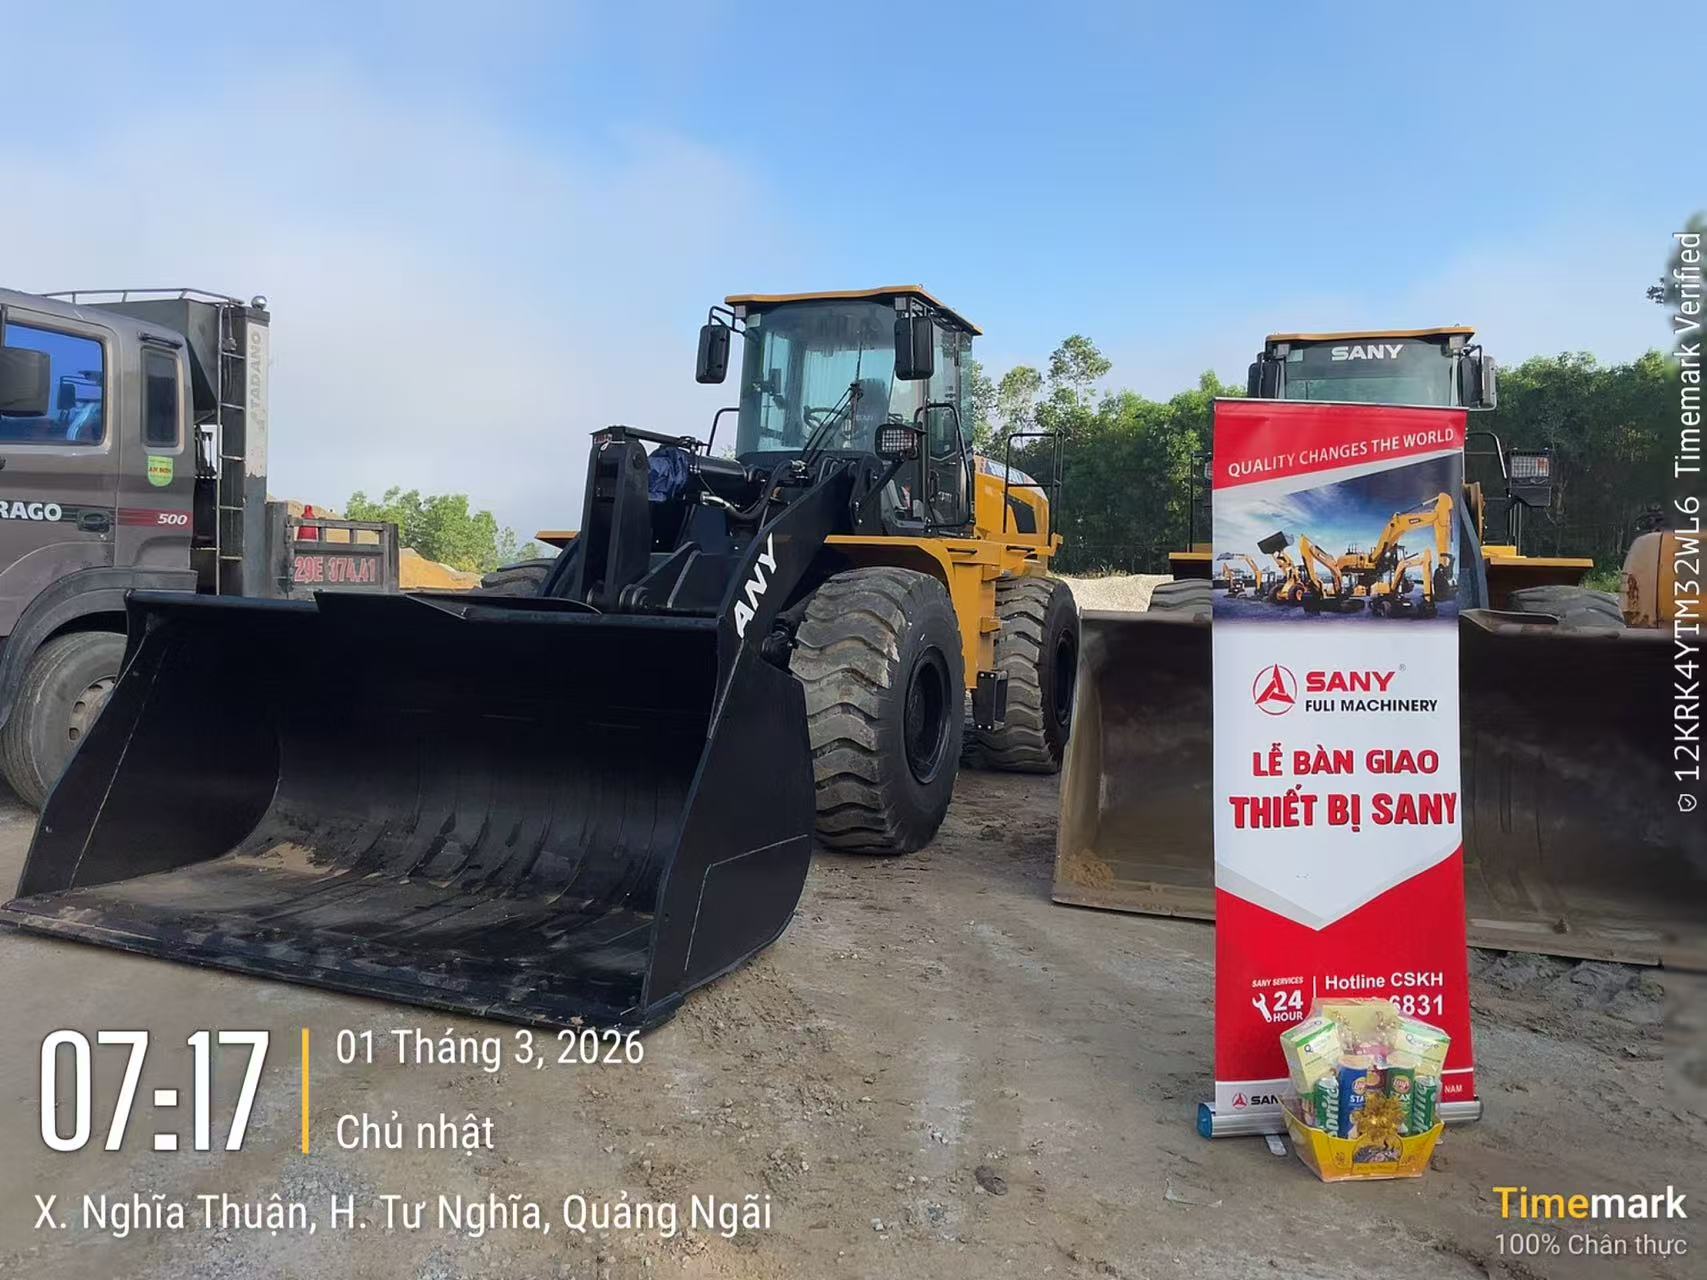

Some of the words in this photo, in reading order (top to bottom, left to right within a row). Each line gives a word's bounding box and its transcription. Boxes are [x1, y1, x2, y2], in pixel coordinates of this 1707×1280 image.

[1330, 343, 1405, 361] SANY
[251, 331, 262, 408] TADANO
[1228, 452, 1296, 478] QUALITY
[1299, 442, 1368, 466] CHANGES
[1371, 436, 1400, 453] THE
[1403, 428, 1455, 449] WORLD
[0, 500, 62, 521] RAGO
[157, 513, 188, 525] 500
[294, 556, 324, 584] 29E
[734, 532, 777, 639] ANY
[1306, 671, 1396, 692] SANY
[1305, 700, 1335, 712] FULI
[1341, 699, 1438, 712] MACHINERY
[1252, 742, 1284, 777] LỄ
[1293, 744, 1354, 775] BÀN
[1366, 749, 1439, 774] GIAO
[1229, 784, 1318, 829] THIẾT
[1327, 793, 1361, 833] BỊ
[1371, 792, 1457, 825] SANY
[1251, 979, 1272, 988] SANY
[1272, 976, 1304, 986] SERVICES
[1325, 974, 1386, 990] Hotline
[1390, 972, 1444, 987] CSKH
[1273, 990, 1304, 1012] 24
[1273, 1011, 1304, 1022] HOUR
[1350, 1094, 1364, 1103] STA
[1444, 1085, 1463, 1094] NAM
[1251, 1094, 1279, 1105] SAN
